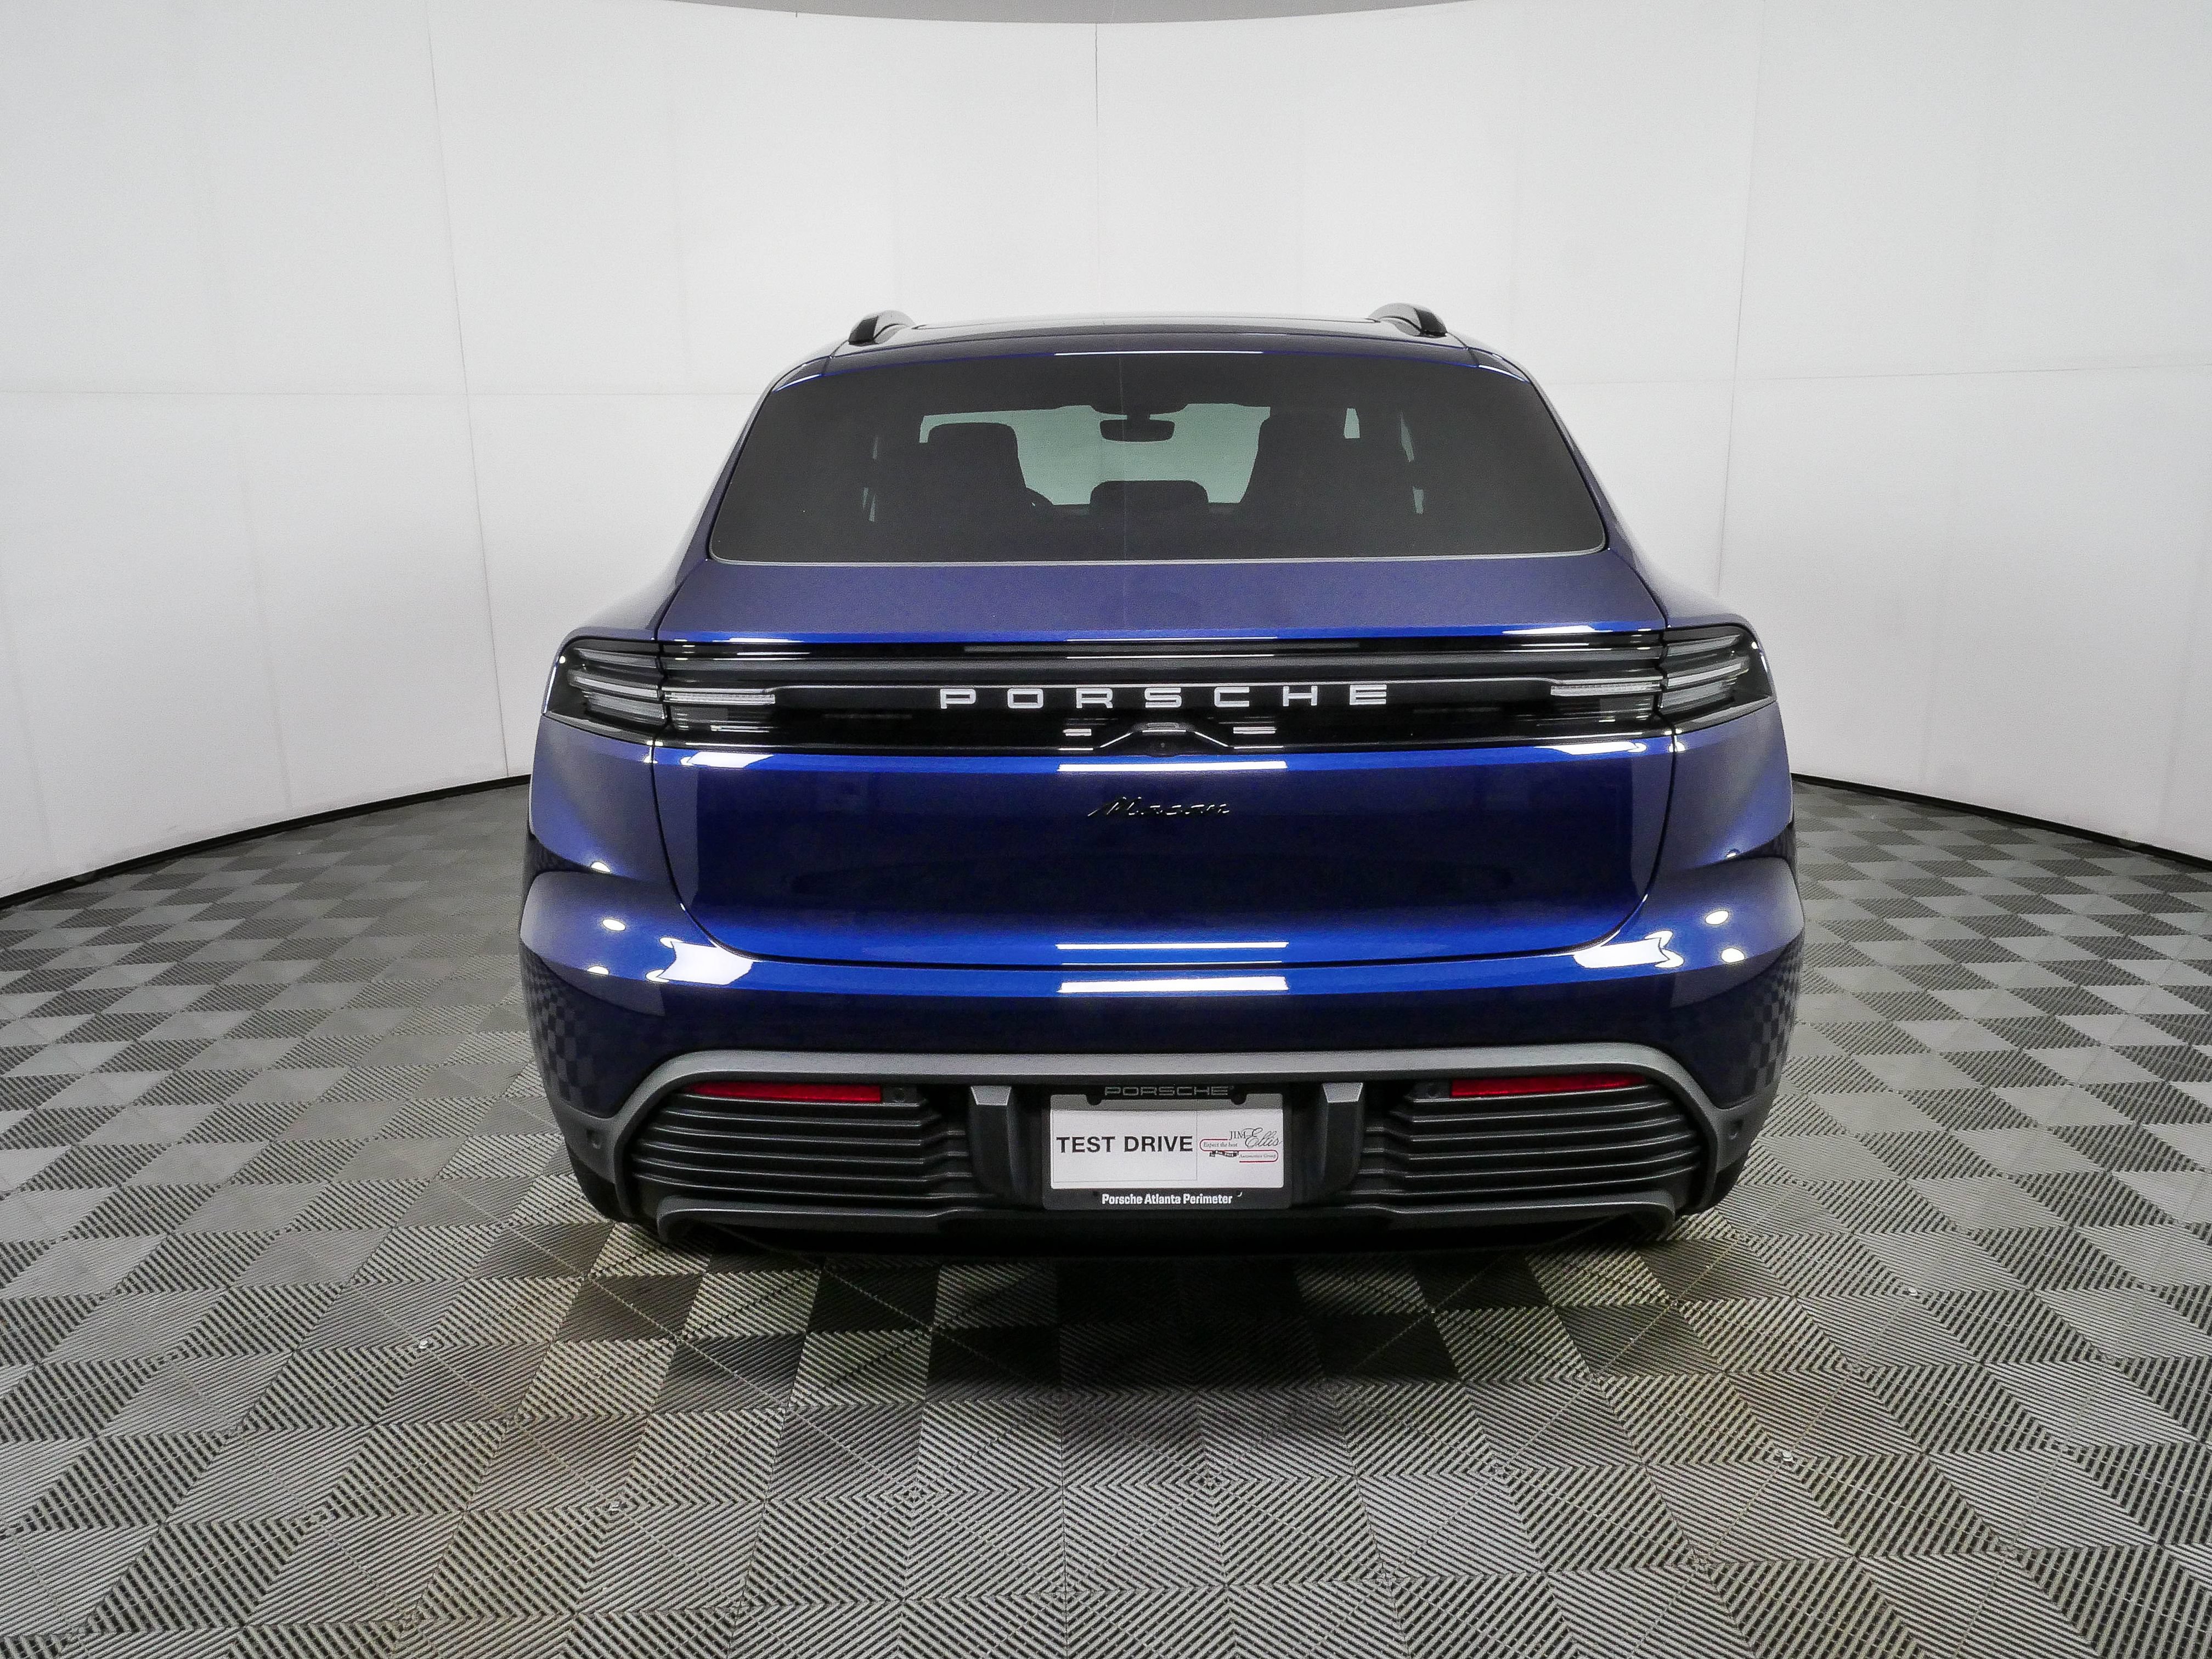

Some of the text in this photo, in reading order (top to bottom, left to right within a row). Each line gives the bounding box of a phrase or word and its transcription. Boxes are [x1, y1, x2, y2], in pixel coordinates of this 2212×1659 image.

[940, 684, 1387, 709] PORSCHE
[1104, 1085, 1229, 1096] PORSCHE
[1056, 1136, 1194, 1153] TEST DRIVE
[1229, 1127, 1283, 1148] JIM Ellis
[1102, 1194, 1233, 1204] Porsche Atlanta Perimeter
